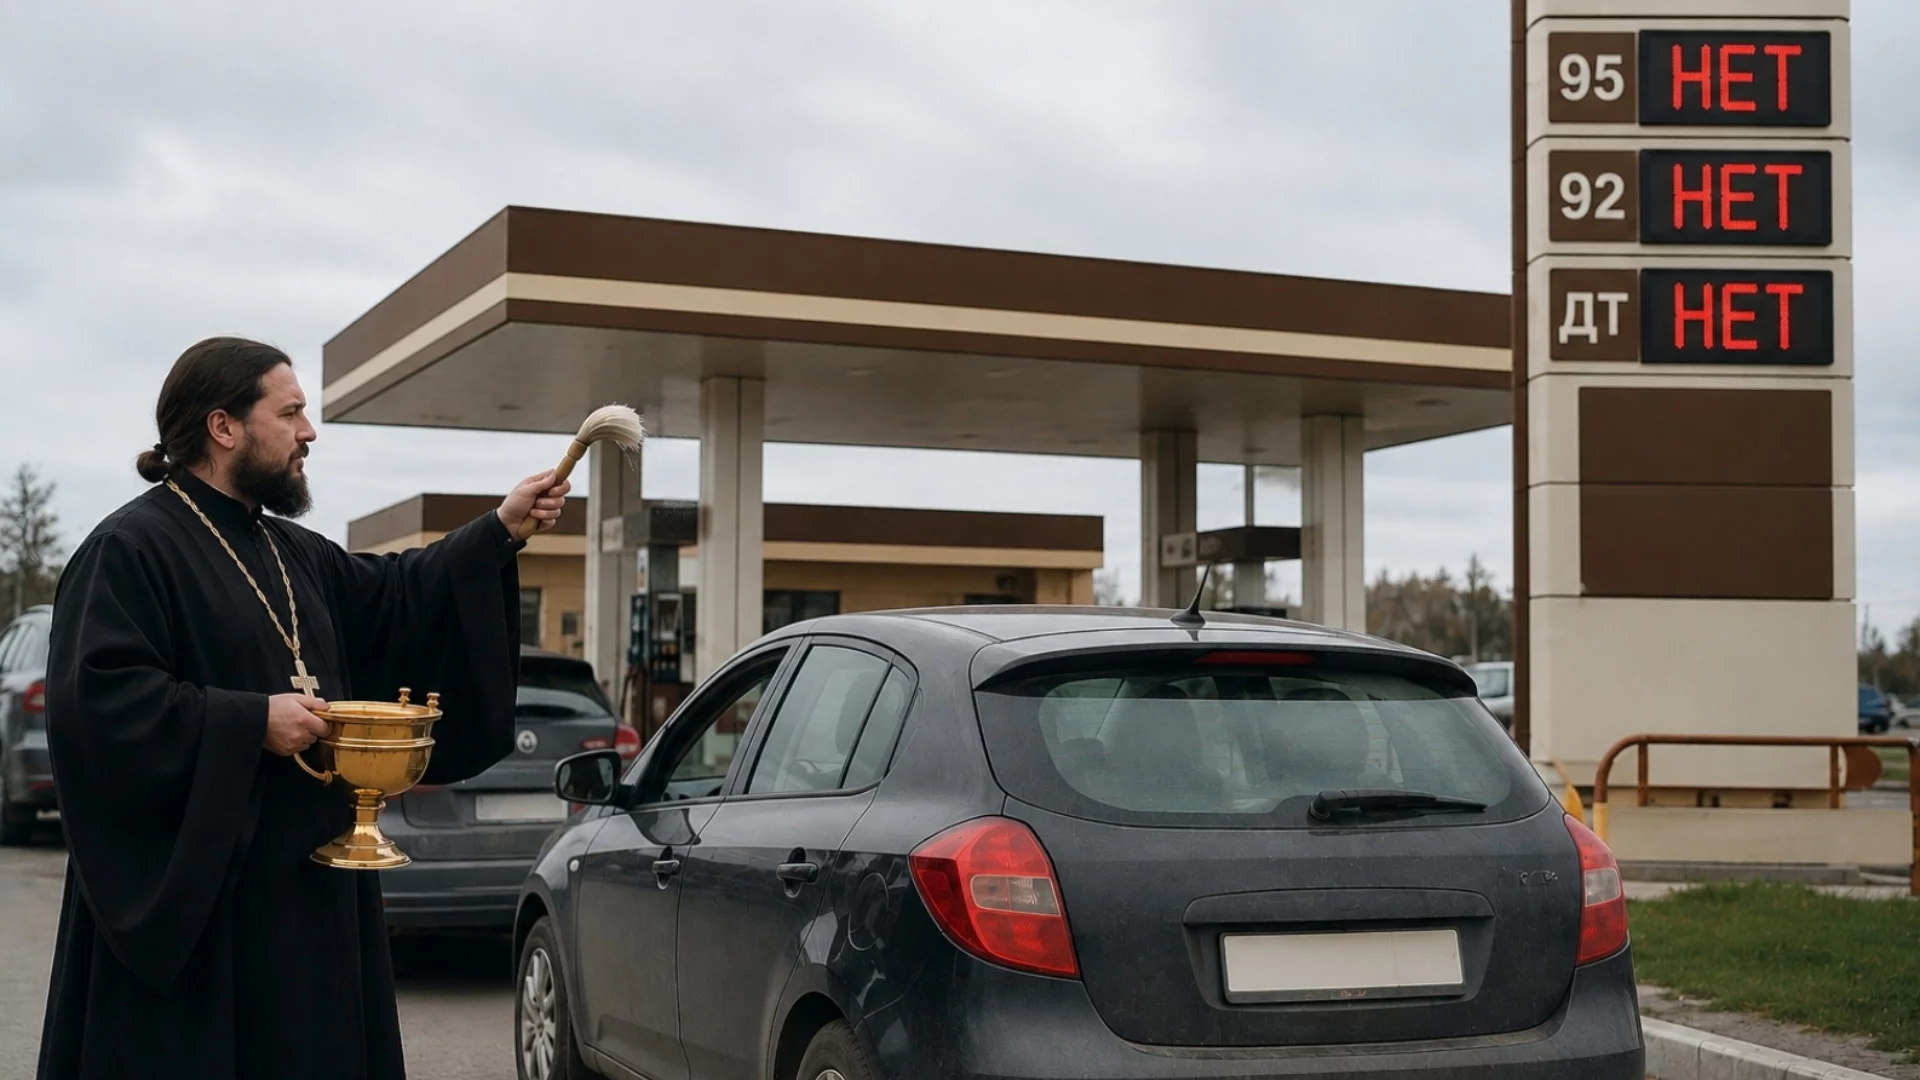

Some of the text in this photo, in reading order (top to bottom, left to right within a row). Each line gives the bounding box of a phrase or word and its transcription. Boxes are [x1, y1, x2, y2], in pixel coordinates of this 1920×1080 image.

[1558, 53, 1625, 102] 95
[1671, 43, 1803, 112] НЕТ
[1559, 171, 1626, 220] 92
[1672, 162, 1804, 231] НЕТ
[1558, 291, 1629, 345] ДТ
[1673, 281, 1805, 351] НЕТ
